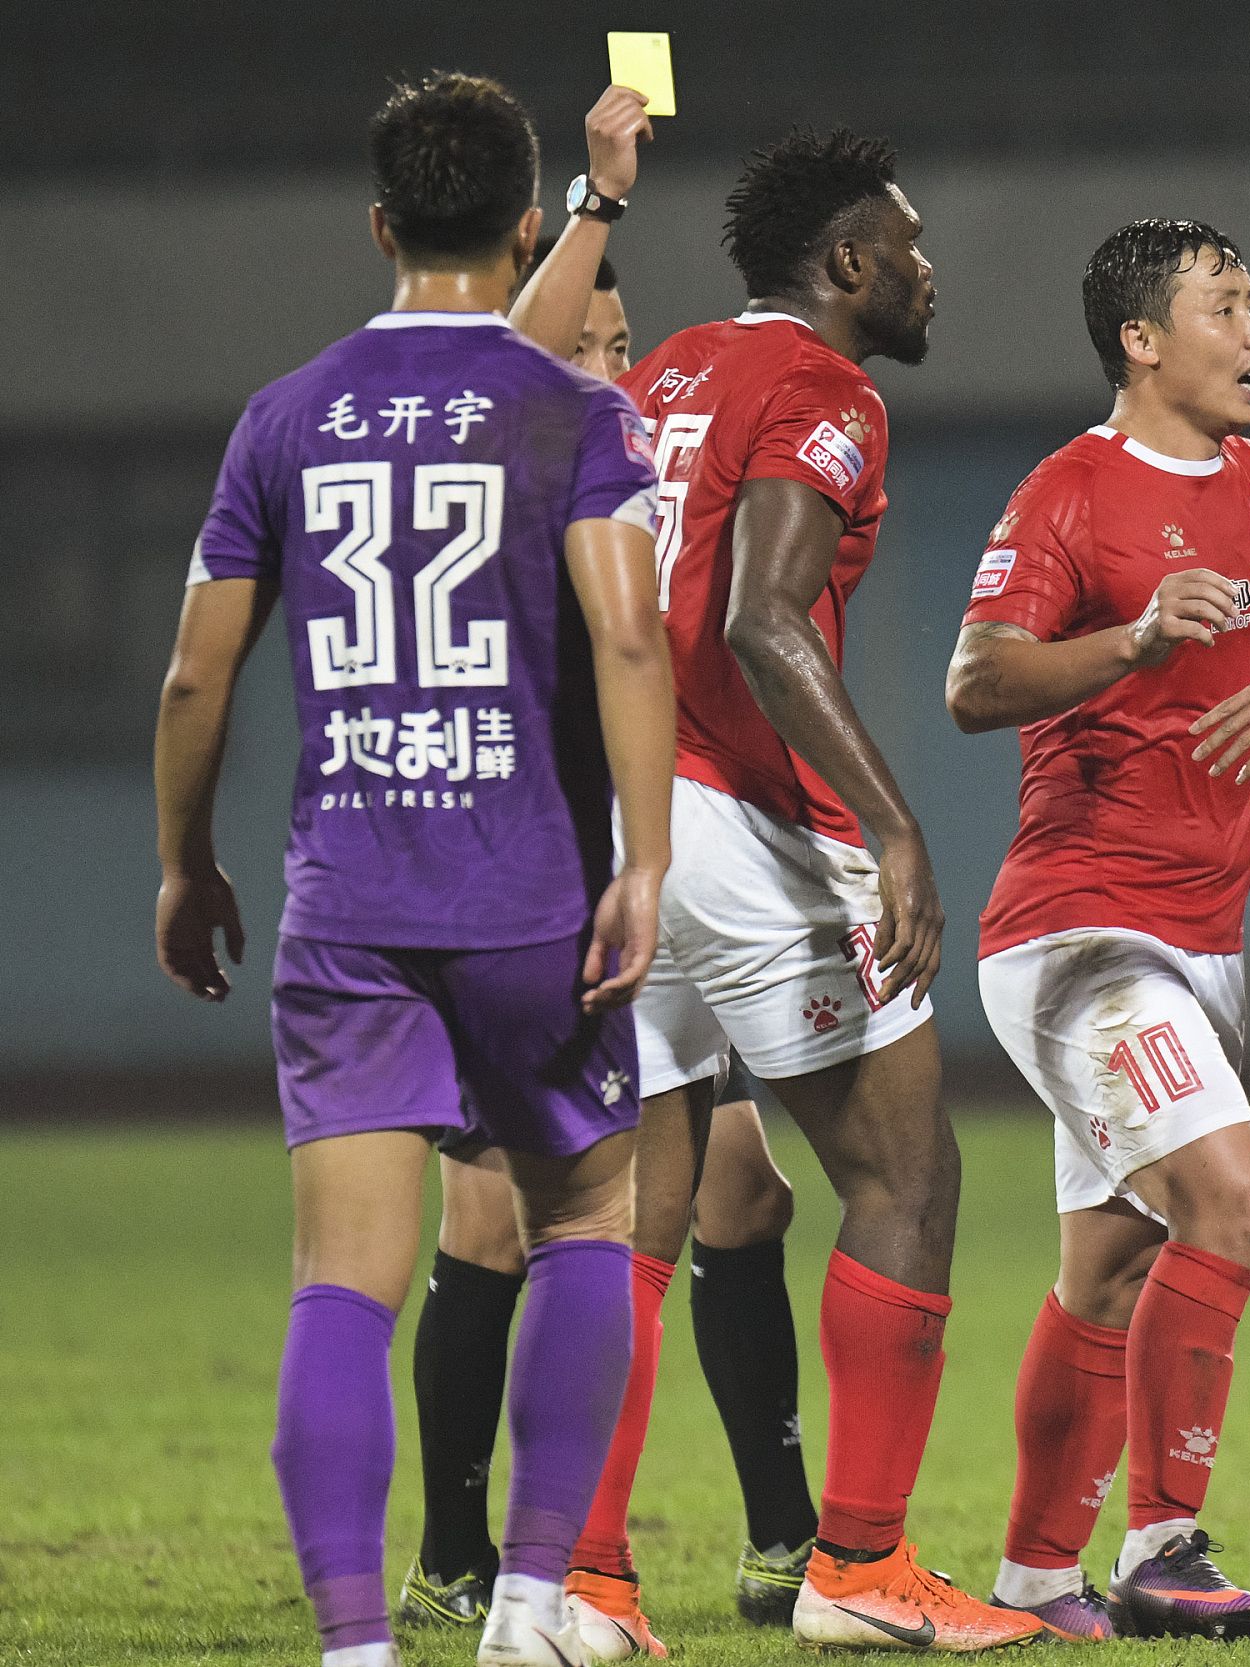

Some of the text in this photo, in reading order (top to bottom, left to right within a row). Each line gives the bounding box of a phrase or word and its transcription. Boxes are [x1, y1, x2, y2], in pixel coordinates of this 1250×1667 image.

[318, 390, 494, 444] 毛开宇
[1164, 548, 1197, 559] KELME
[302, 461, 509, 691] 32
[1236, 614, 1250, 629] OF
[385, 789, 475, 810] FRESH
[1107, 1021, 1205, 1115] 10
[1169, 1448, 1217, 1469] KELME
